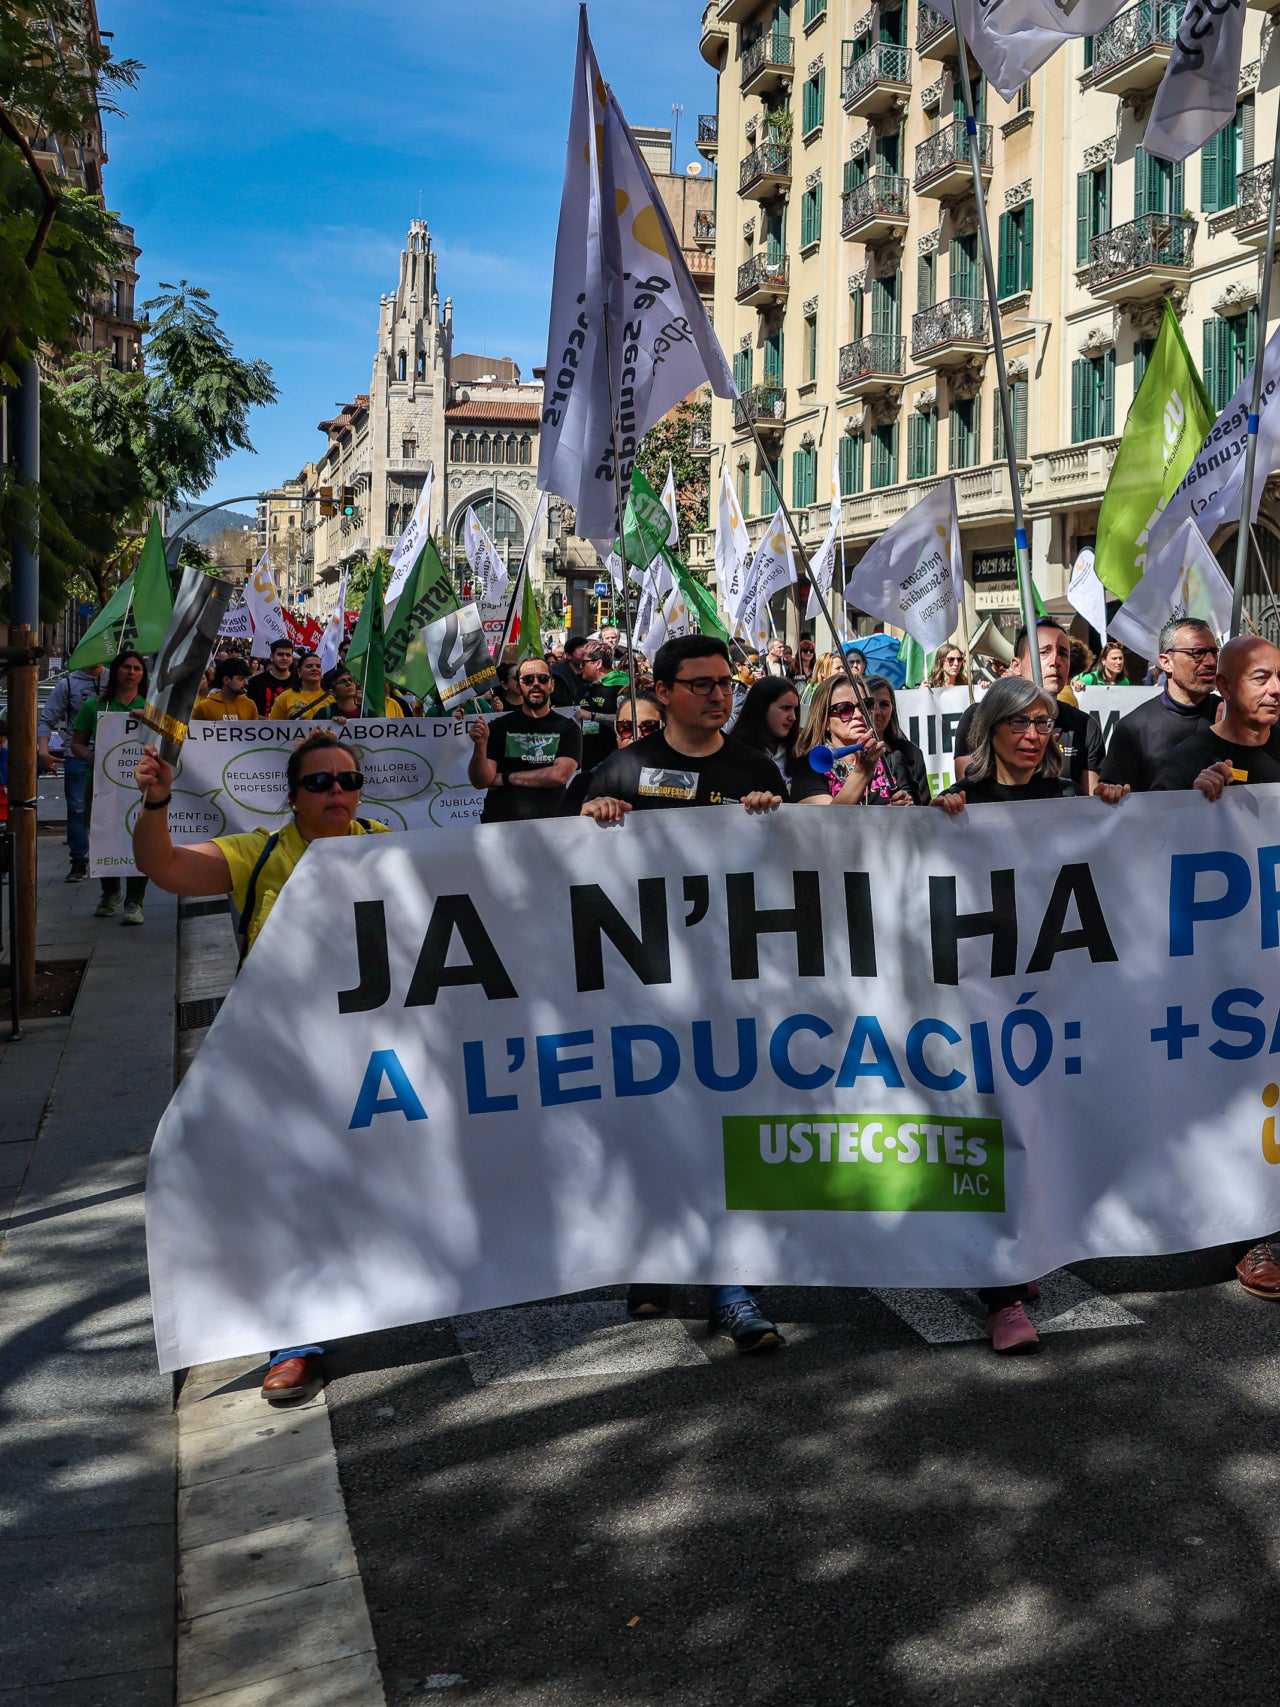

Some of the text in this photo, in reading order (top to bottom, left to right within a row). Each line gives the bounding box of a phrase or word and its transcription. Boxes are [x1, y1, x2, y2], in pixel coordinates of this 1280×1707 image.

[338, 723, 426, 740] ABORAL
[364, 762, 417, 773] MILLORES
[203, 812, 220, 822] DE
[450, 810, 469, 819] ALS
[337, 893, 519, 1014] JA
[569, 870, 878, 993] N'HI
[928, 862, 1119, 986] HA
[348, 1048, 428, 1130] A
[952, 1171, 990, 1197] IAC
